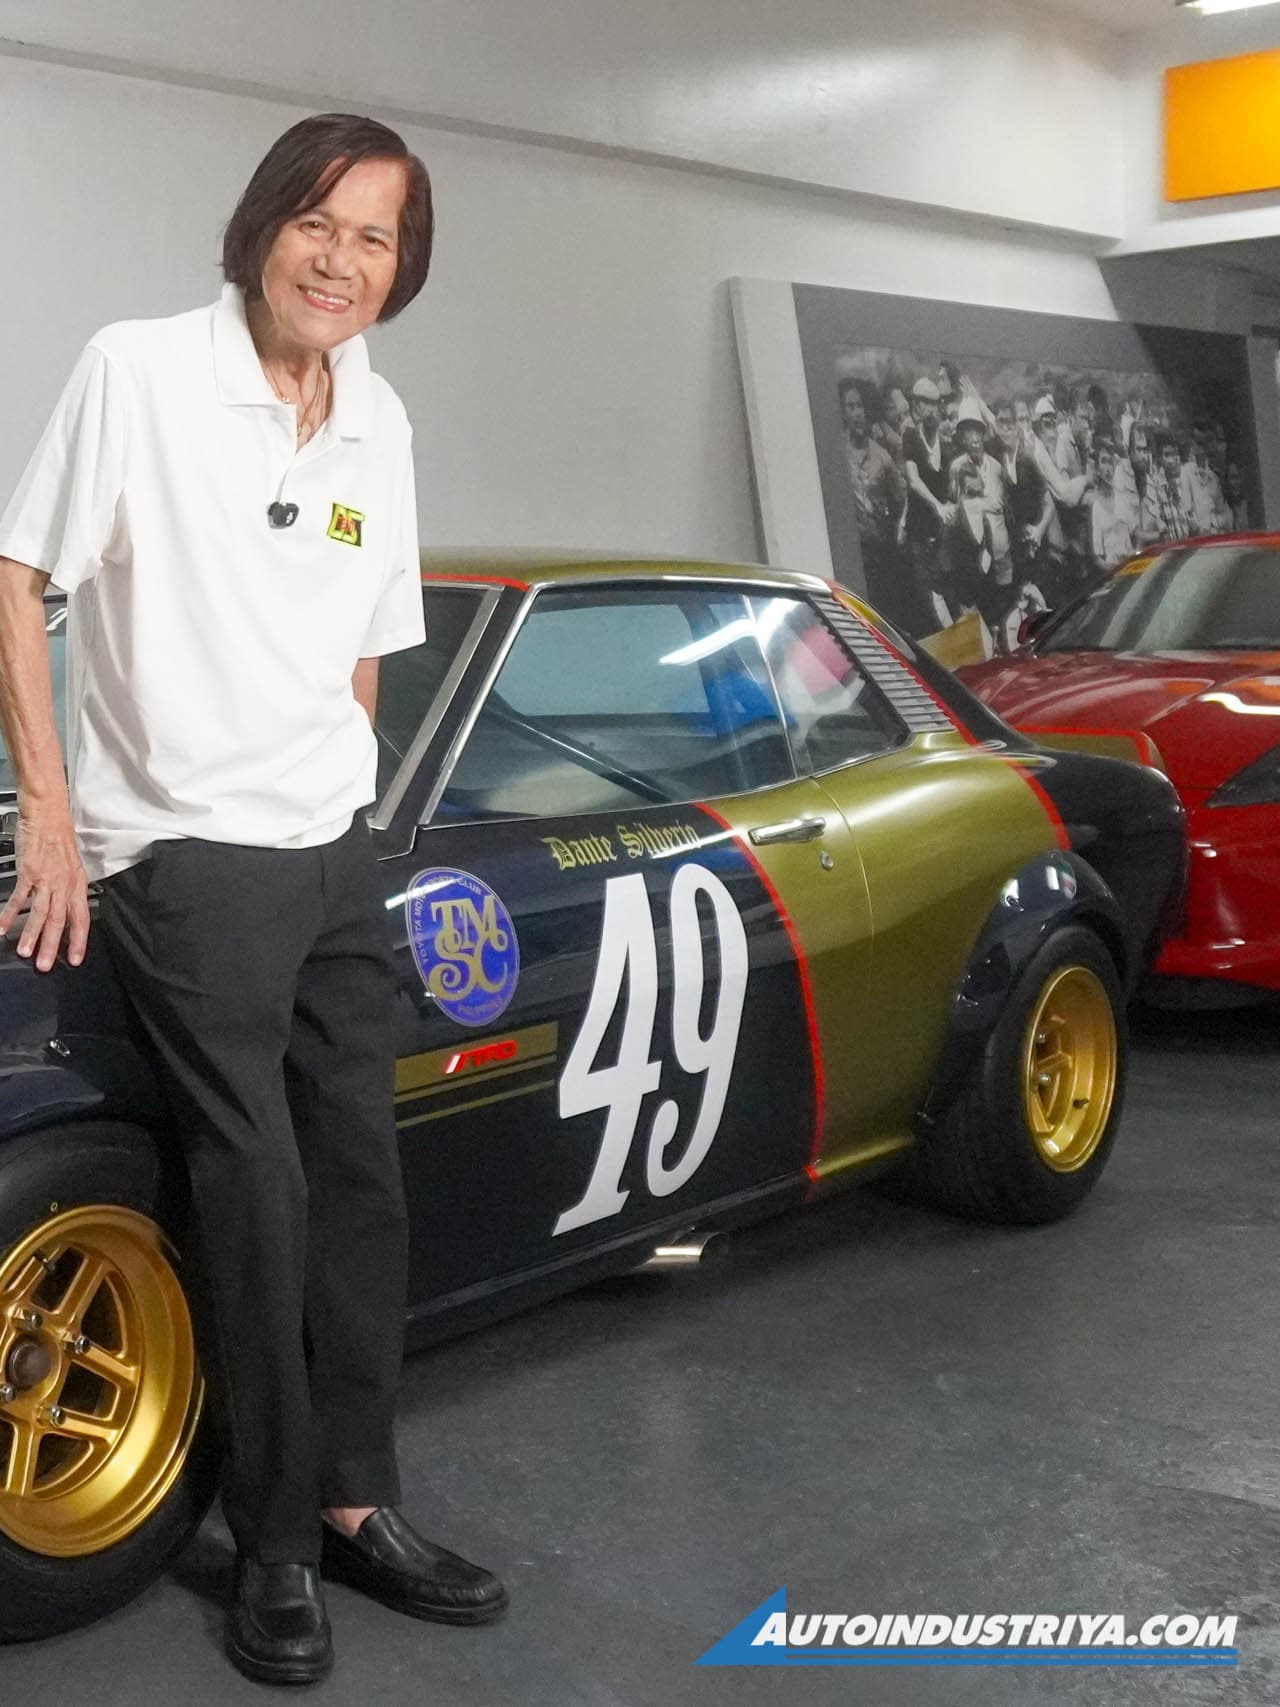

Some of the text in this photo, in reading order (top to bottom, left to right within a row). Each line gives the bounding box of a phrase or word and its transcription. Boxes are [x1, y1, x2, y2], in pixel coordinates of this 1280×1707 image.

[541, 833, 618, 871] Dante
[460, 1040, 517, 1070] TRD
[552, 863, 749, 1236] 49
